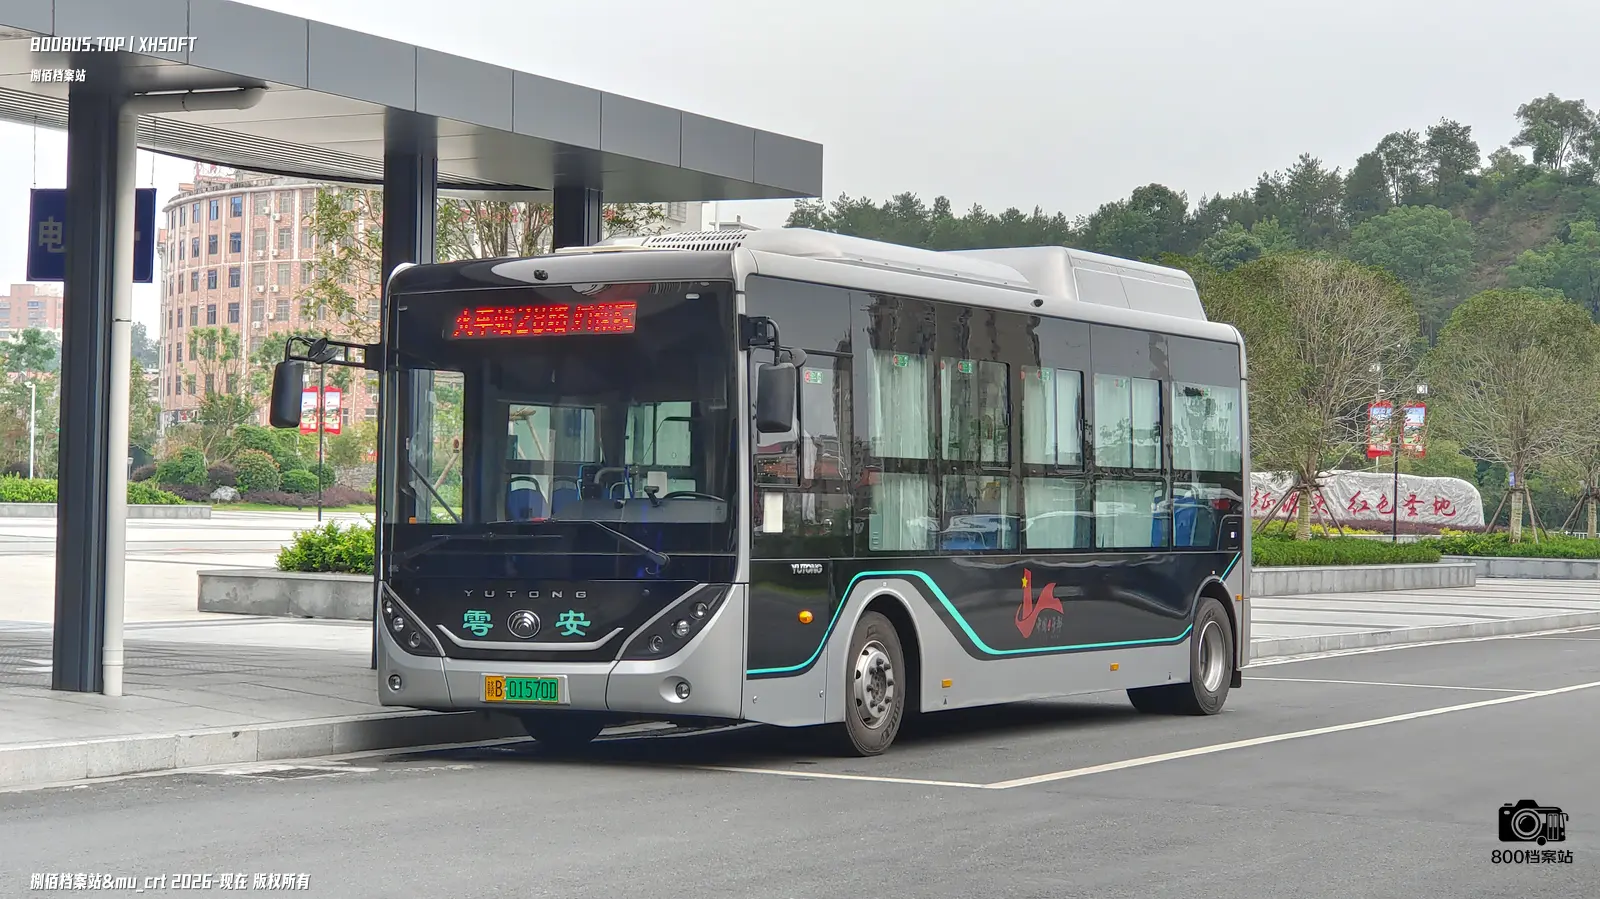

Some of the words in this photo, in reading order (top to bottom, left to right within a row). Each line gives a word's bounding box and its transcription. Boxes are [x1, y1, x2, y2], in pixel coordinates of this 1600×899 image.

[791, 563, 823, 575] YUTONG
[464, 589, 587, 598] YUTONG
[555, 609, 591, 637] 安
